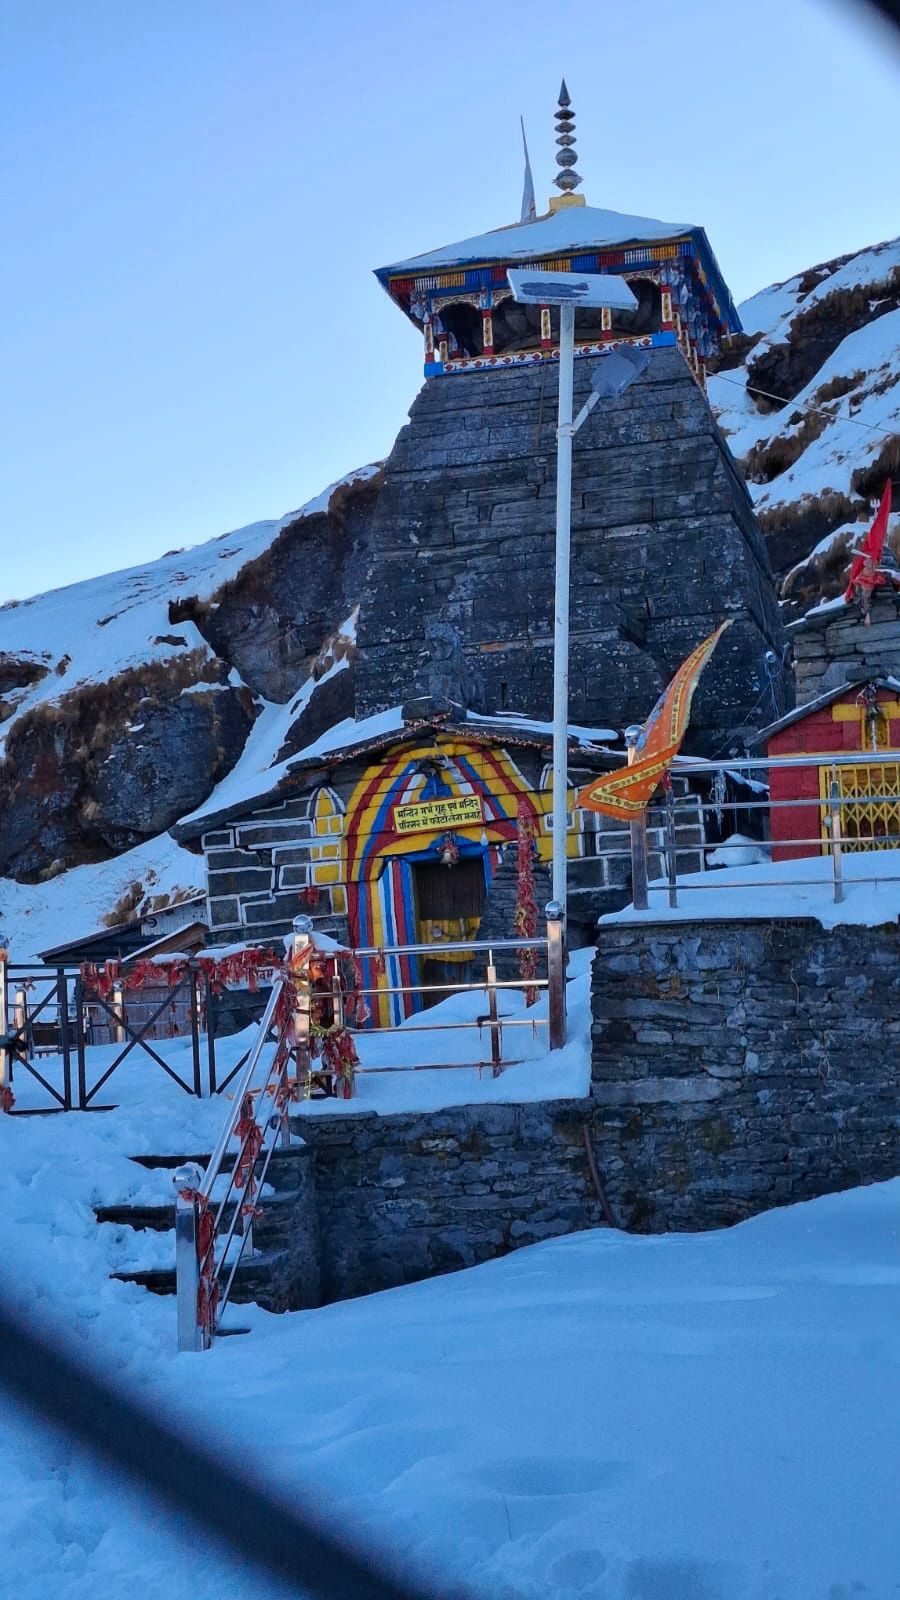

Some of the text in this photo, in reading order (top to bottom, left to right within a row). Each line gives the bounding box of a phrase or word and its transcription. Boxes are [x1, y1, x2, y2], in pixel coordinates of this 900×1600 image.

[397, 806, 418, 819] मन्दिर
[435, 804, 447, 816] गृह
[459, 798, 479, 809] मन्दिर
